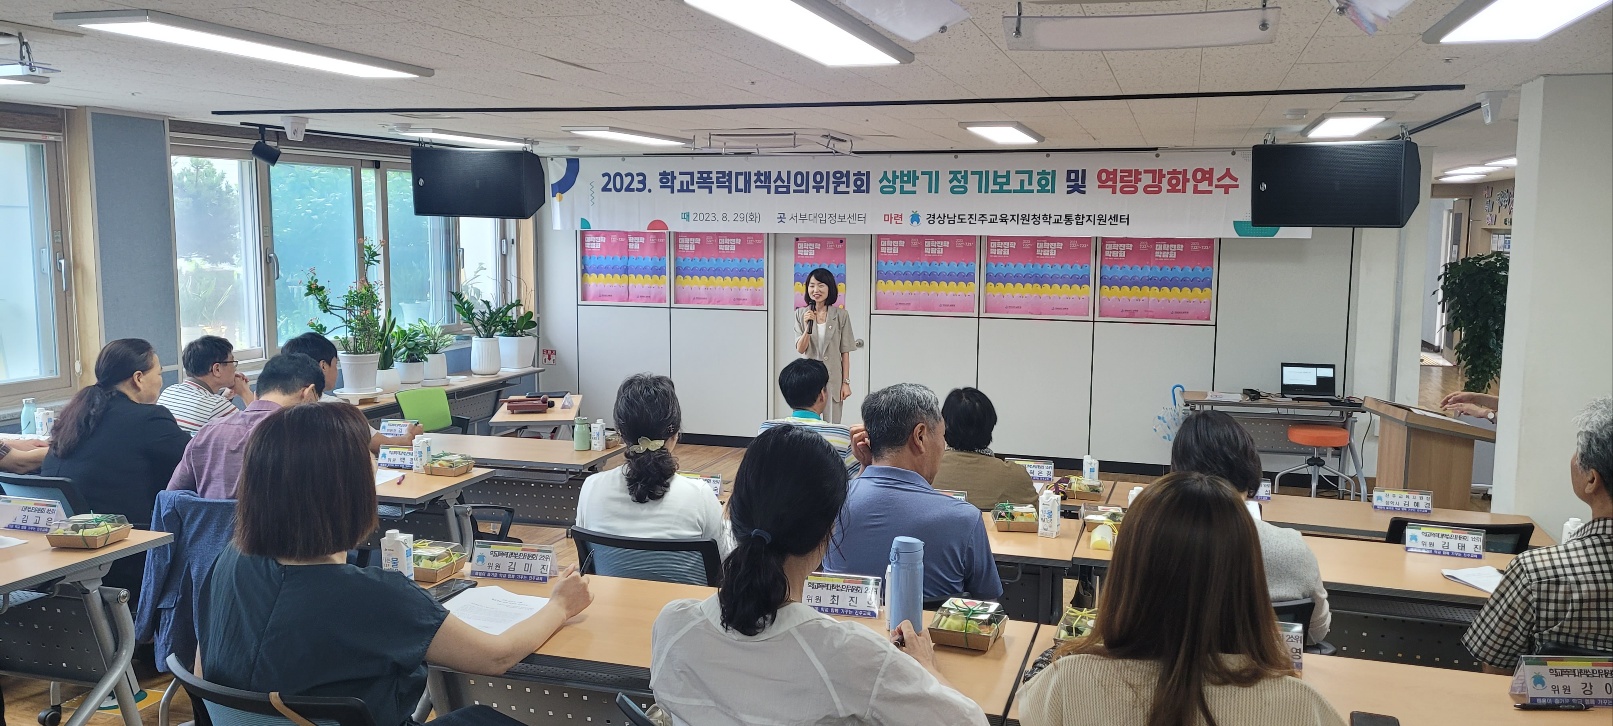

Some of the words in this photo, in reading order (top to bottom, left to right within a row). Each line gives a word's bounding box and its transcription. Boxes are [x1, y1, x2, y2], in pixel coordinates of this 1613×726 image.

[600, 172, 652, 193] 2023.
[658, 170, 871, 195] 학교폭력대책심의위원회
[878, 169, 940, 195] 상반기
[948, 169, 1056, 195] 정기보고회
[1066, 168, 1087, 195] 및
[1096, 167, 1240, 195] 역량강화연수
[680, 211, 690, 223] 때
[692, 212, 719, 223] 2023.
[721, 212, 730, 223] 8.
[732, 211, 761, 224] 29(화)
[776, 212, 787, 224] 곳
[789, 212, 867, 225] 서부대입정보센터
[883, 212, 903, 225] 마련
[925, 212, 1130, 226] 경상남도진주교육지원청학교통합지원센터
[507, 561, 549, 575] 김미진
[806, 594, 822, 604] 위원
[1550, 684, 1572, 695] 위원
